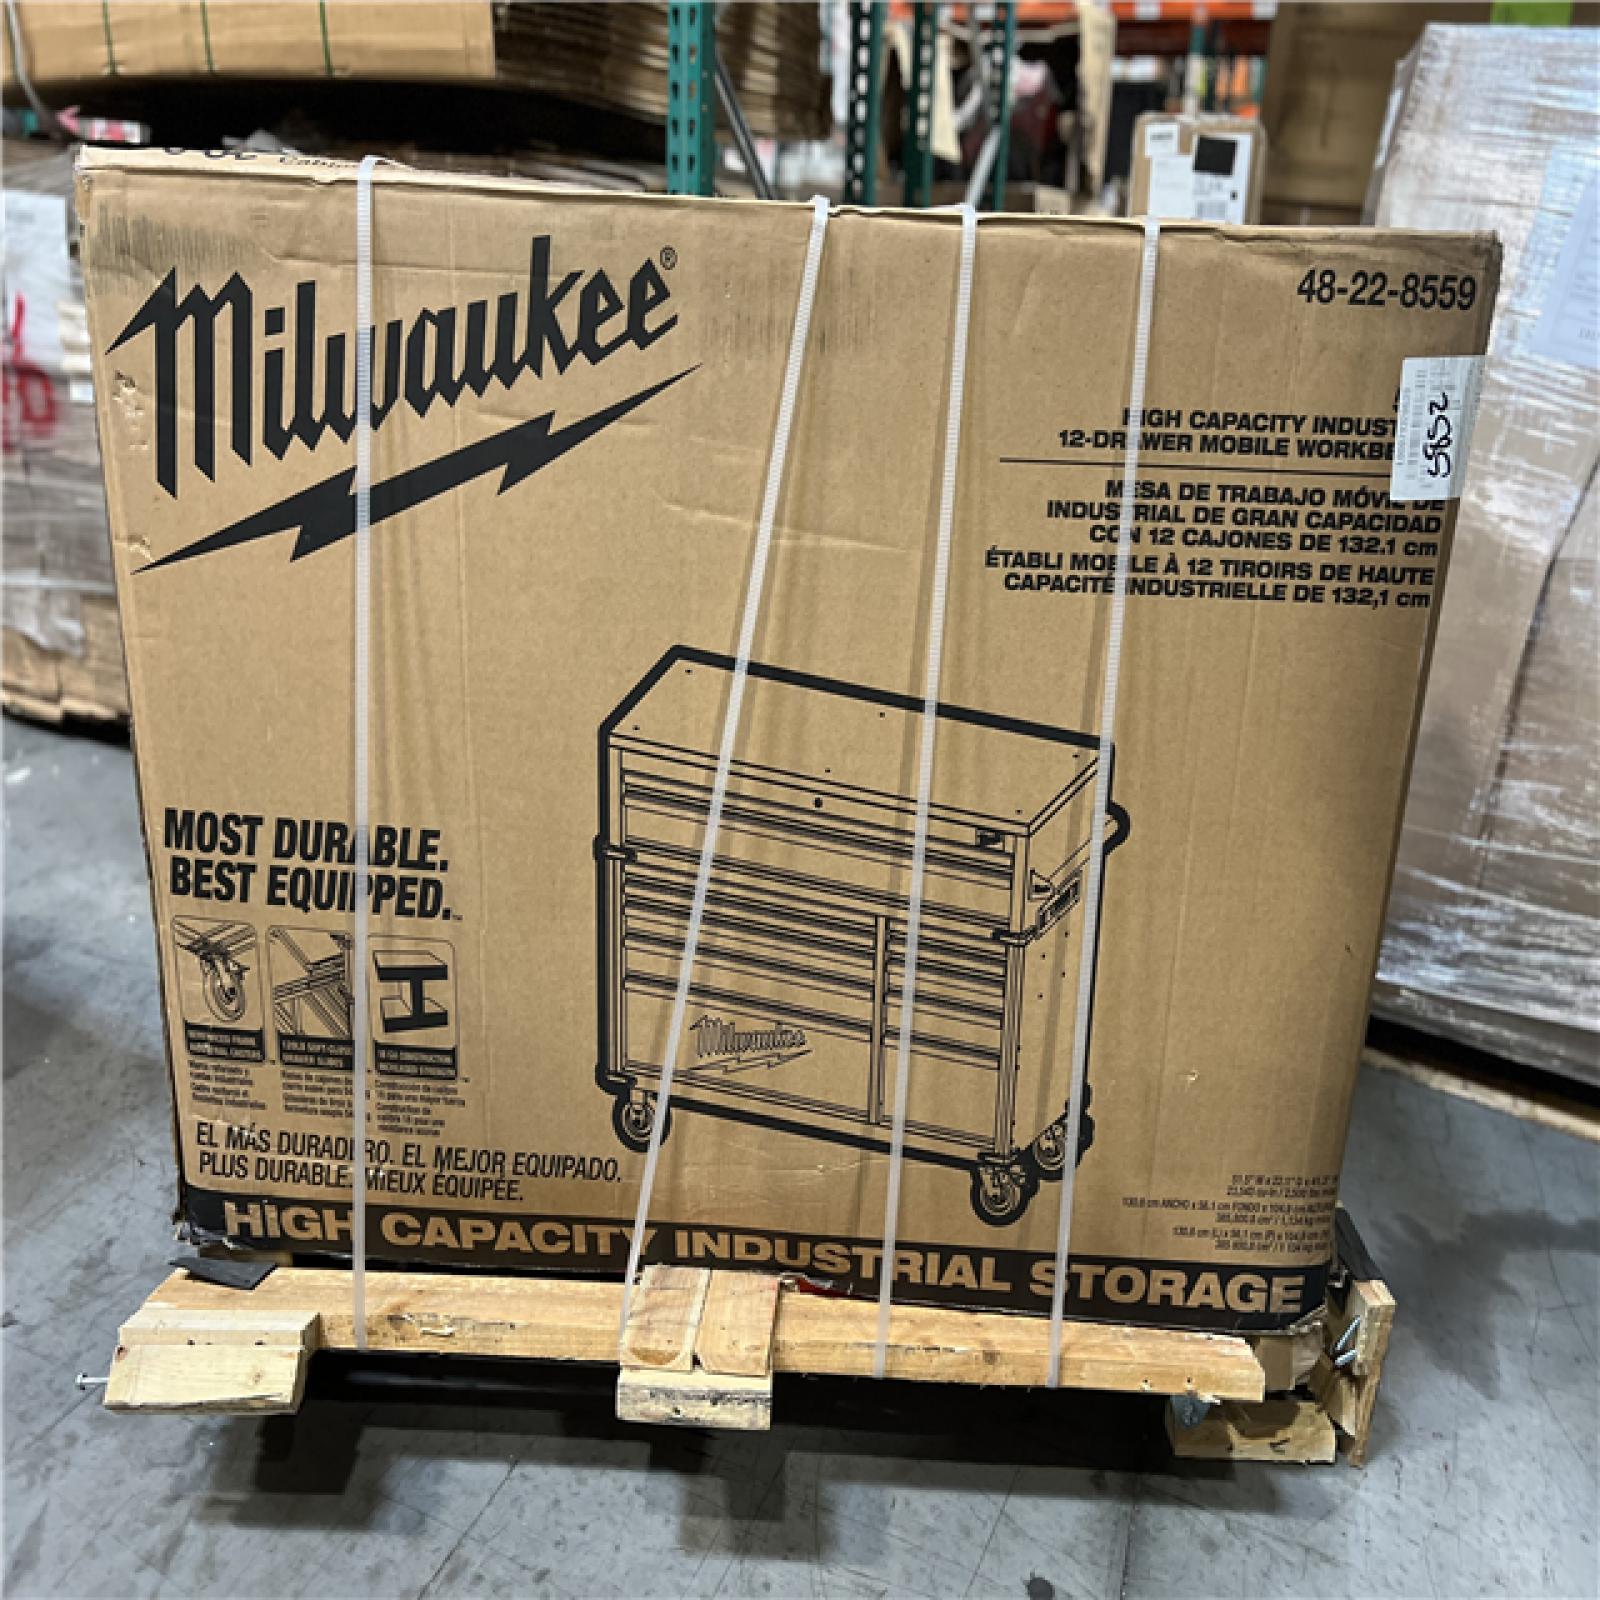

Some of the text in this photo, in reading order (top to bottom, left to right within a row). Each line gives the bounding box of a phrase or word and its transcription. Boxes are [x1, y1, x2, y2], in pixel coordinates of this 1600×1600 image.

[1297, 268, 1477, 311] 48-22-8559
[1190, 409, 1307, 433] CAPACITY
[1058, 429, 1194, 453] 12-DRWER
[1200, 434, 1291, 456] MOBILE
[1180, 482, 1211, 501] DE
[1217, 484, 1326, 506] TRABAJO
[1047, 500, 1441, 533] INDUSRIAL DE GRAN CAPACIDAD
[1149, 527, 1176, 546] 12
[1182, 528, 1292, 551] CAJONES
[1299, 533, 1331, 552] DE
[1404, 541, 1438, 556] cm
[985, 545, 1063, 569] ÉTABLI
[1164, 552, 1180, 574] À
[1187, 557, 1213, 576] 12
[1219, 558, 1313, 580] TIROIRS
[1319, 563, 1352, 582] DE
[1358, 565, 1435, 586] HAUTE
[1293, 584, 1325, 603] DE
[1395, 592, 1431, 608] cm
[164, 807, 263, 857] MOST
[169, 855, 257, 904] BEST
[197, 1121, 220, 1148] EL
[224, 1122, 271, 1153] MÁS
[402, 1142, 426, 1168] EL
[432, 1144, 506, 1176] MEJOR
[512, 1150, 621, 1183] EQUIPADO.
[199, 1152, 249, 1179] PLUS
[224, 1200, 1306, 1314] HIGH CAPACITY INDUSTRIAL STORAGE
